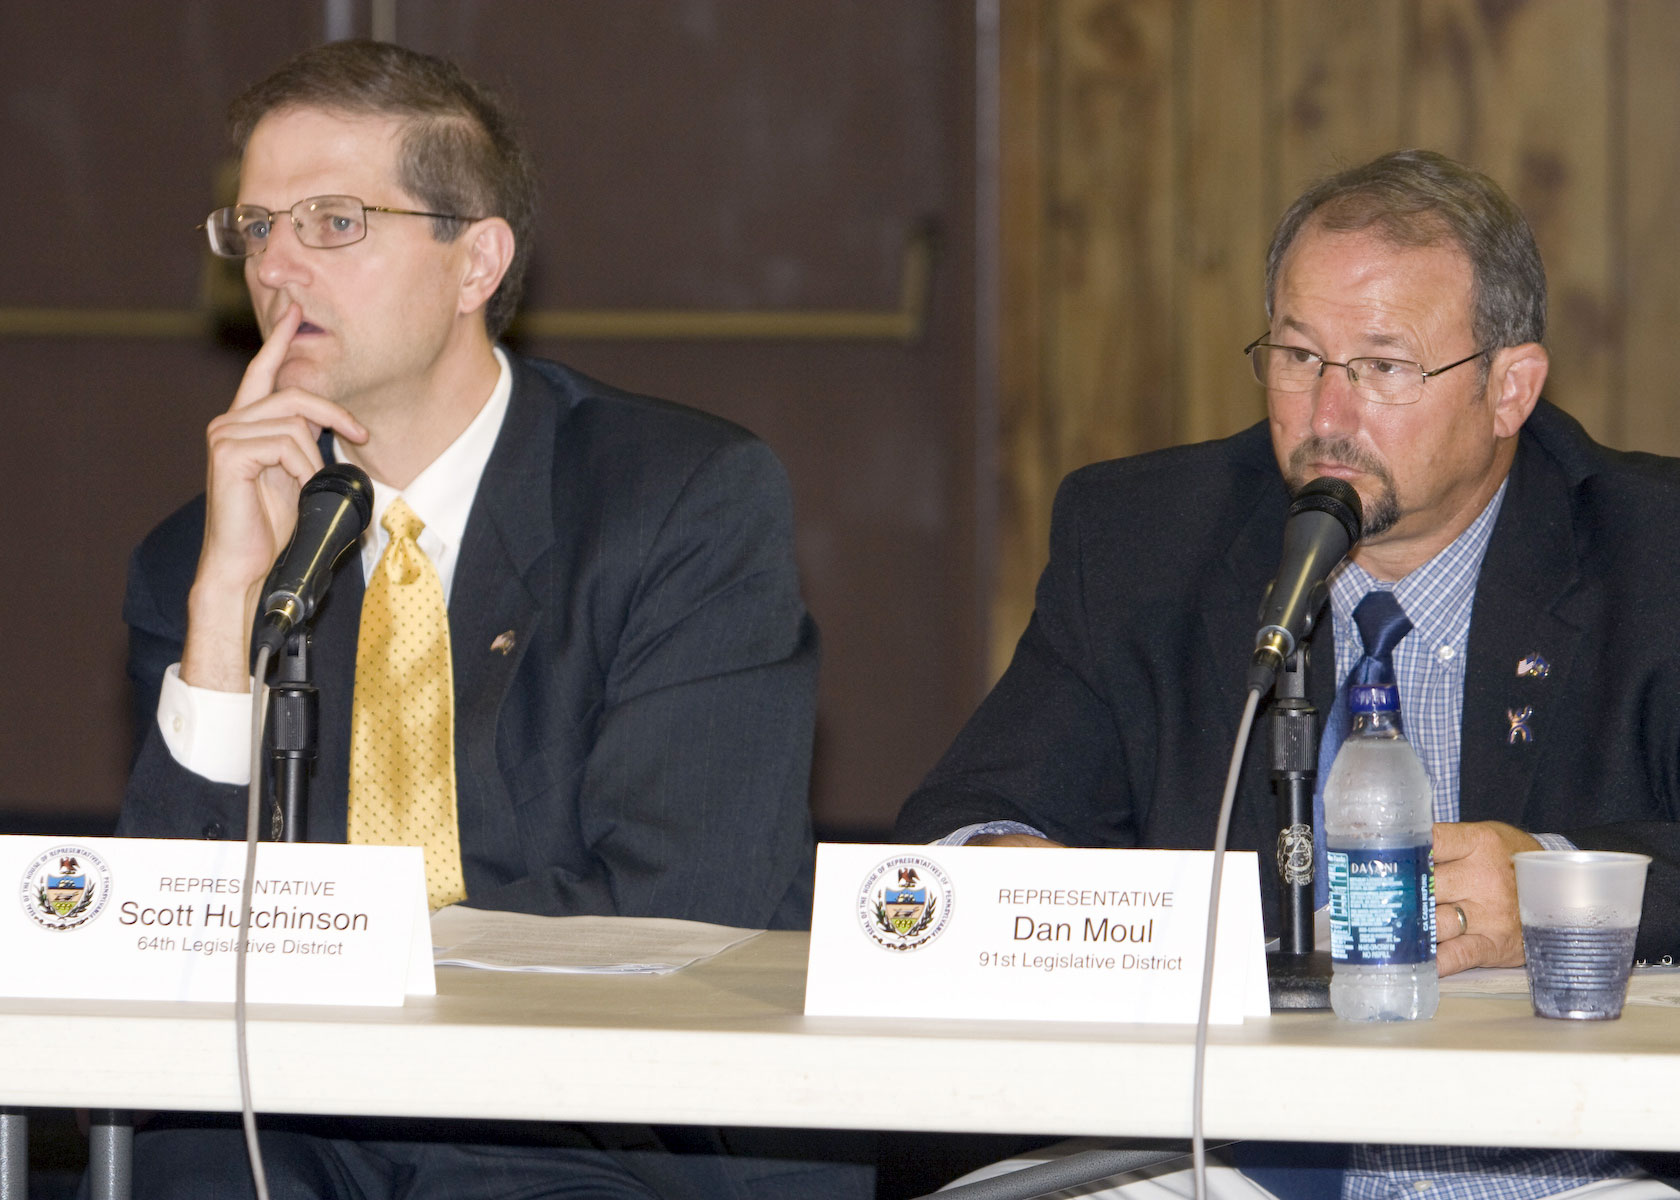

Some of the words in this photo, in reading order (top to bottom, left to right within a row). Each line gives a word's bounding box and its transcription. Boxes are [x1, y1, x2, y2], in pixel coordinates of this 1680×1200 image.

[886, 857, 942, 878] REPRESENTATIVES
[159, 877, 336, 896] REPRESNTATIVE
[999, 888, 1174, 908] REPRESENTATIVE
[119, 901, 194, 927] Scott
[204, 903, 369, 931] Hutchinson
[1013, 915, 1072, 942] Dan
[1083, 917, 1154, 944] Moul
[137, 936, 175, 951] 64th
[282, 939, 344, 955] District
[979, 952, 1017, 967] 91st
[1022, 952, 1116, 972] Legislative
[1122, 954, 1182, 970] District
